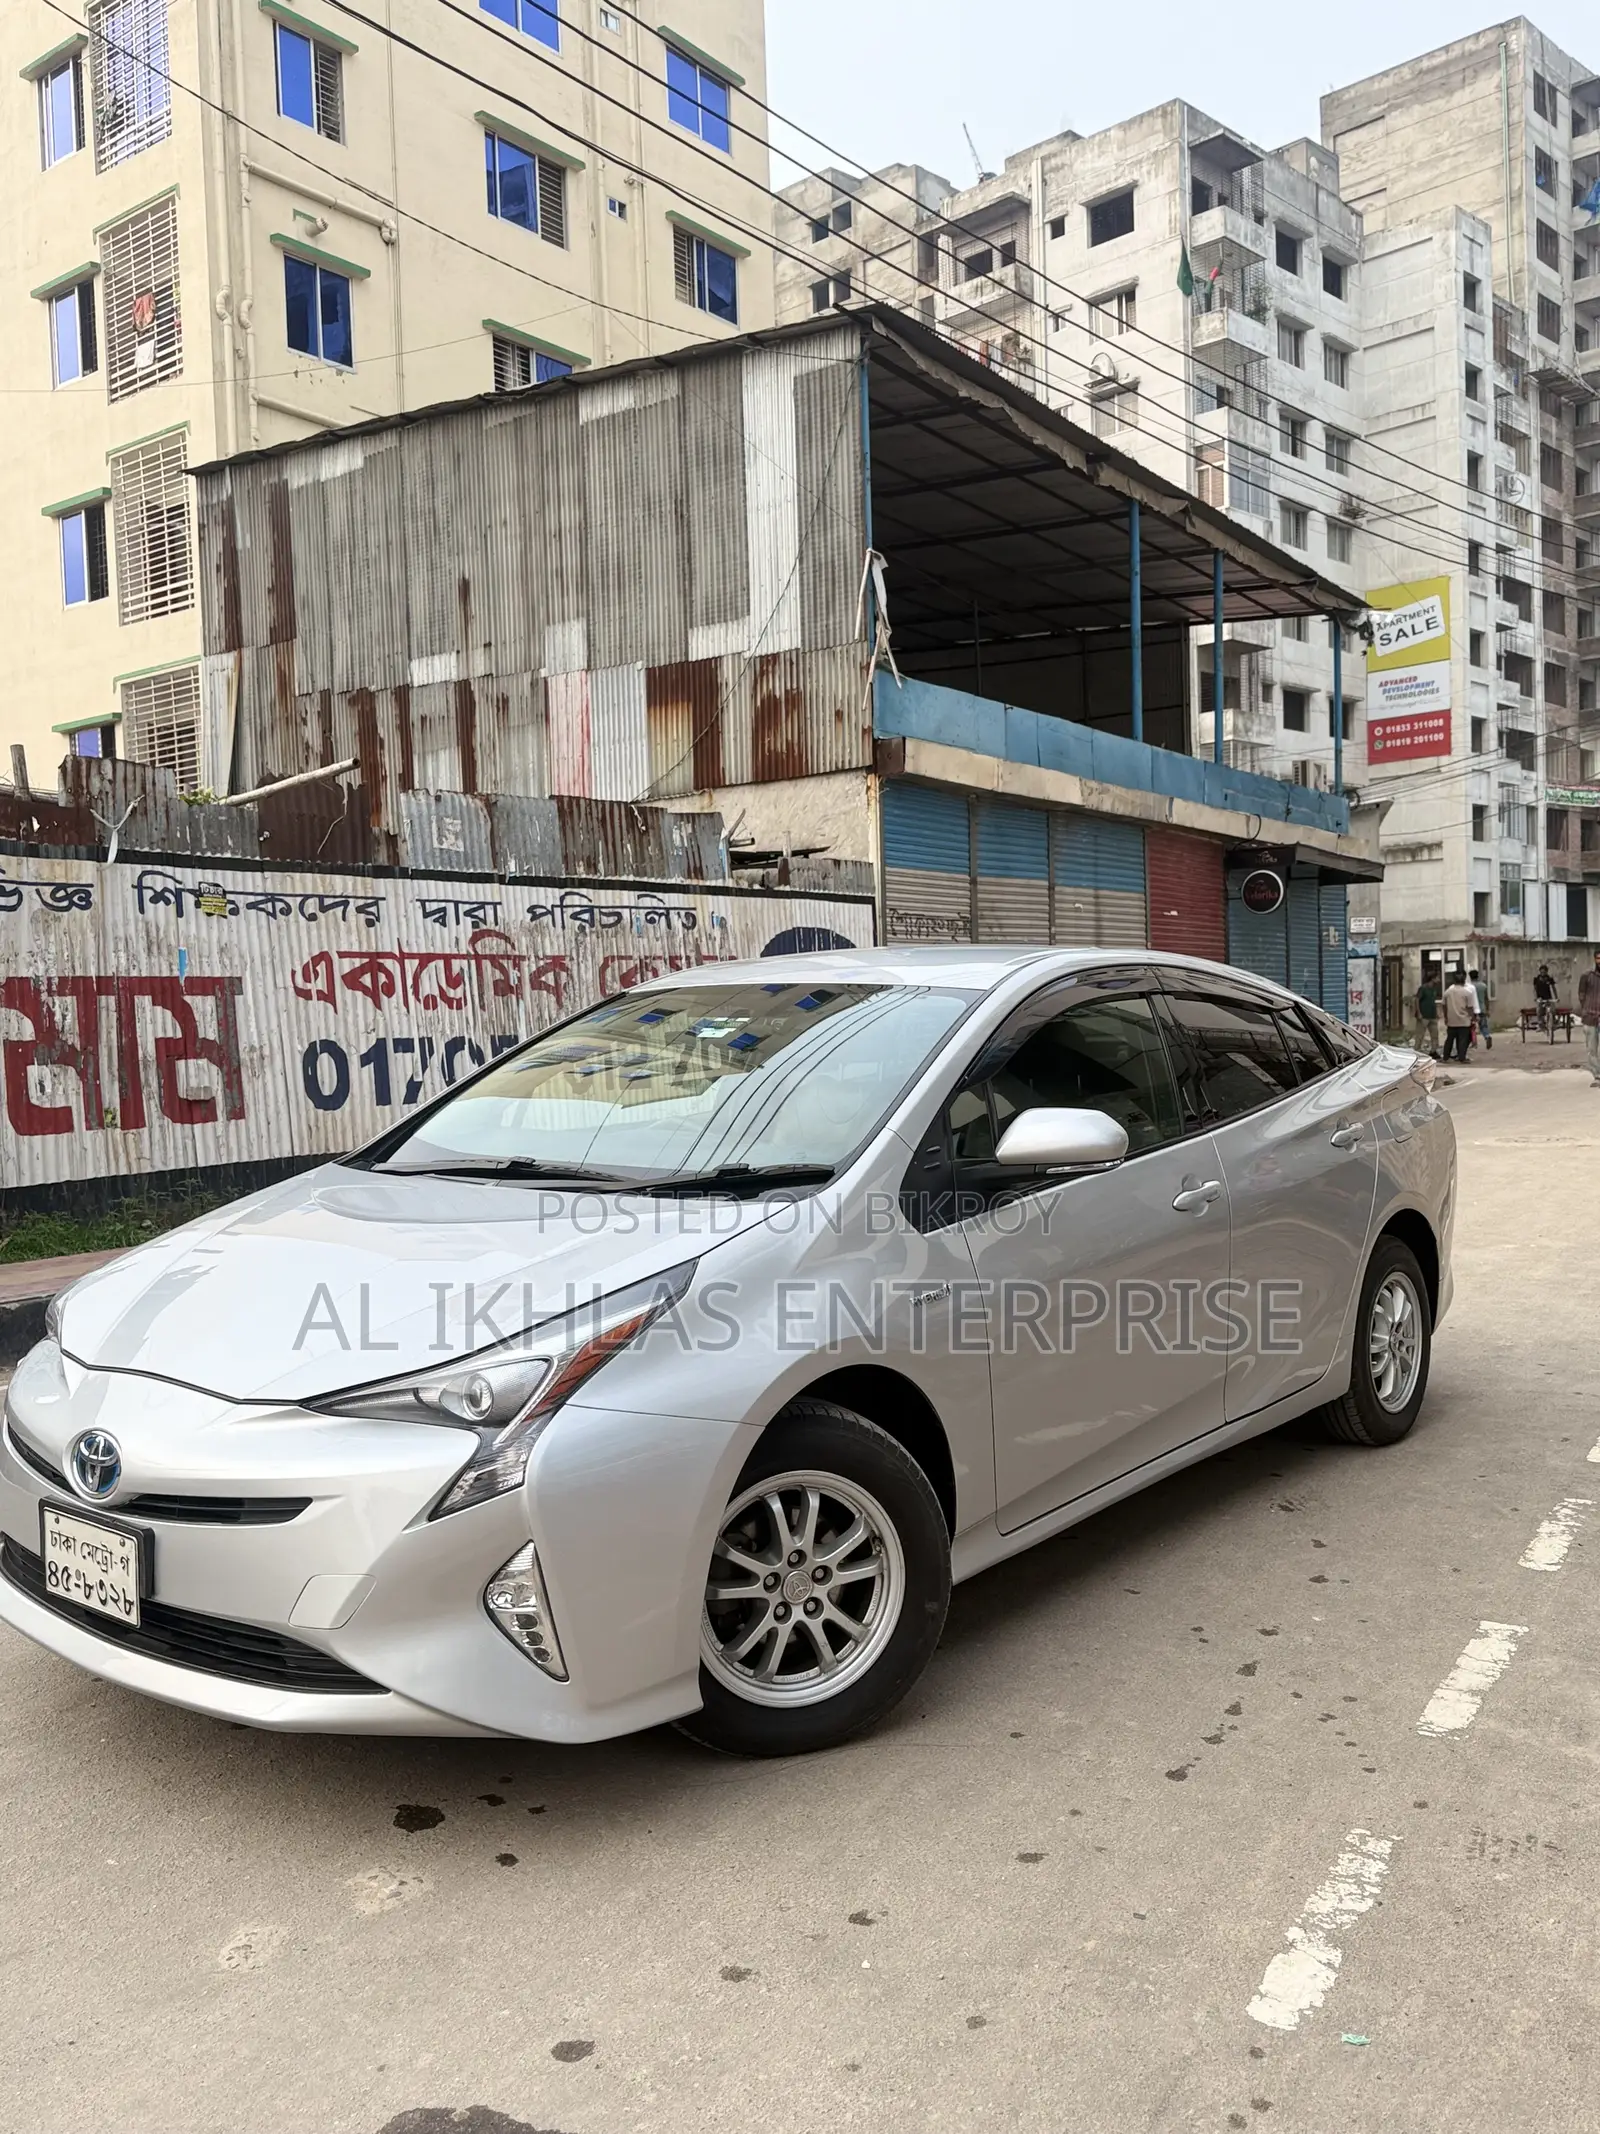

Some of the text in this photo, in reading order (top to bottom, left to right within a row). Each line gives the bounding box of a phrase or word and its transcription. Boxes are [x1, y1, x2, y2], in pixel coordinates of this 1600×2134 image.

[1376, 605, 1436, 632] APARTMENT
[1380, 616, 1440, 646] SALE
[1378, 676, 1418, 688] ADVANCED
[1382, 680, 1435, 695] DEVELOPMENT
[1385, 687, 1440, 702] TECHNOLOGIES
[415, 898, 502, 929] দ্বারা
[526, 891, 697, 931] পরিচালিত
[291, 928, 571, 1015] একাডেমিক
[50, 1529, 77, 1557] ঢাকা
